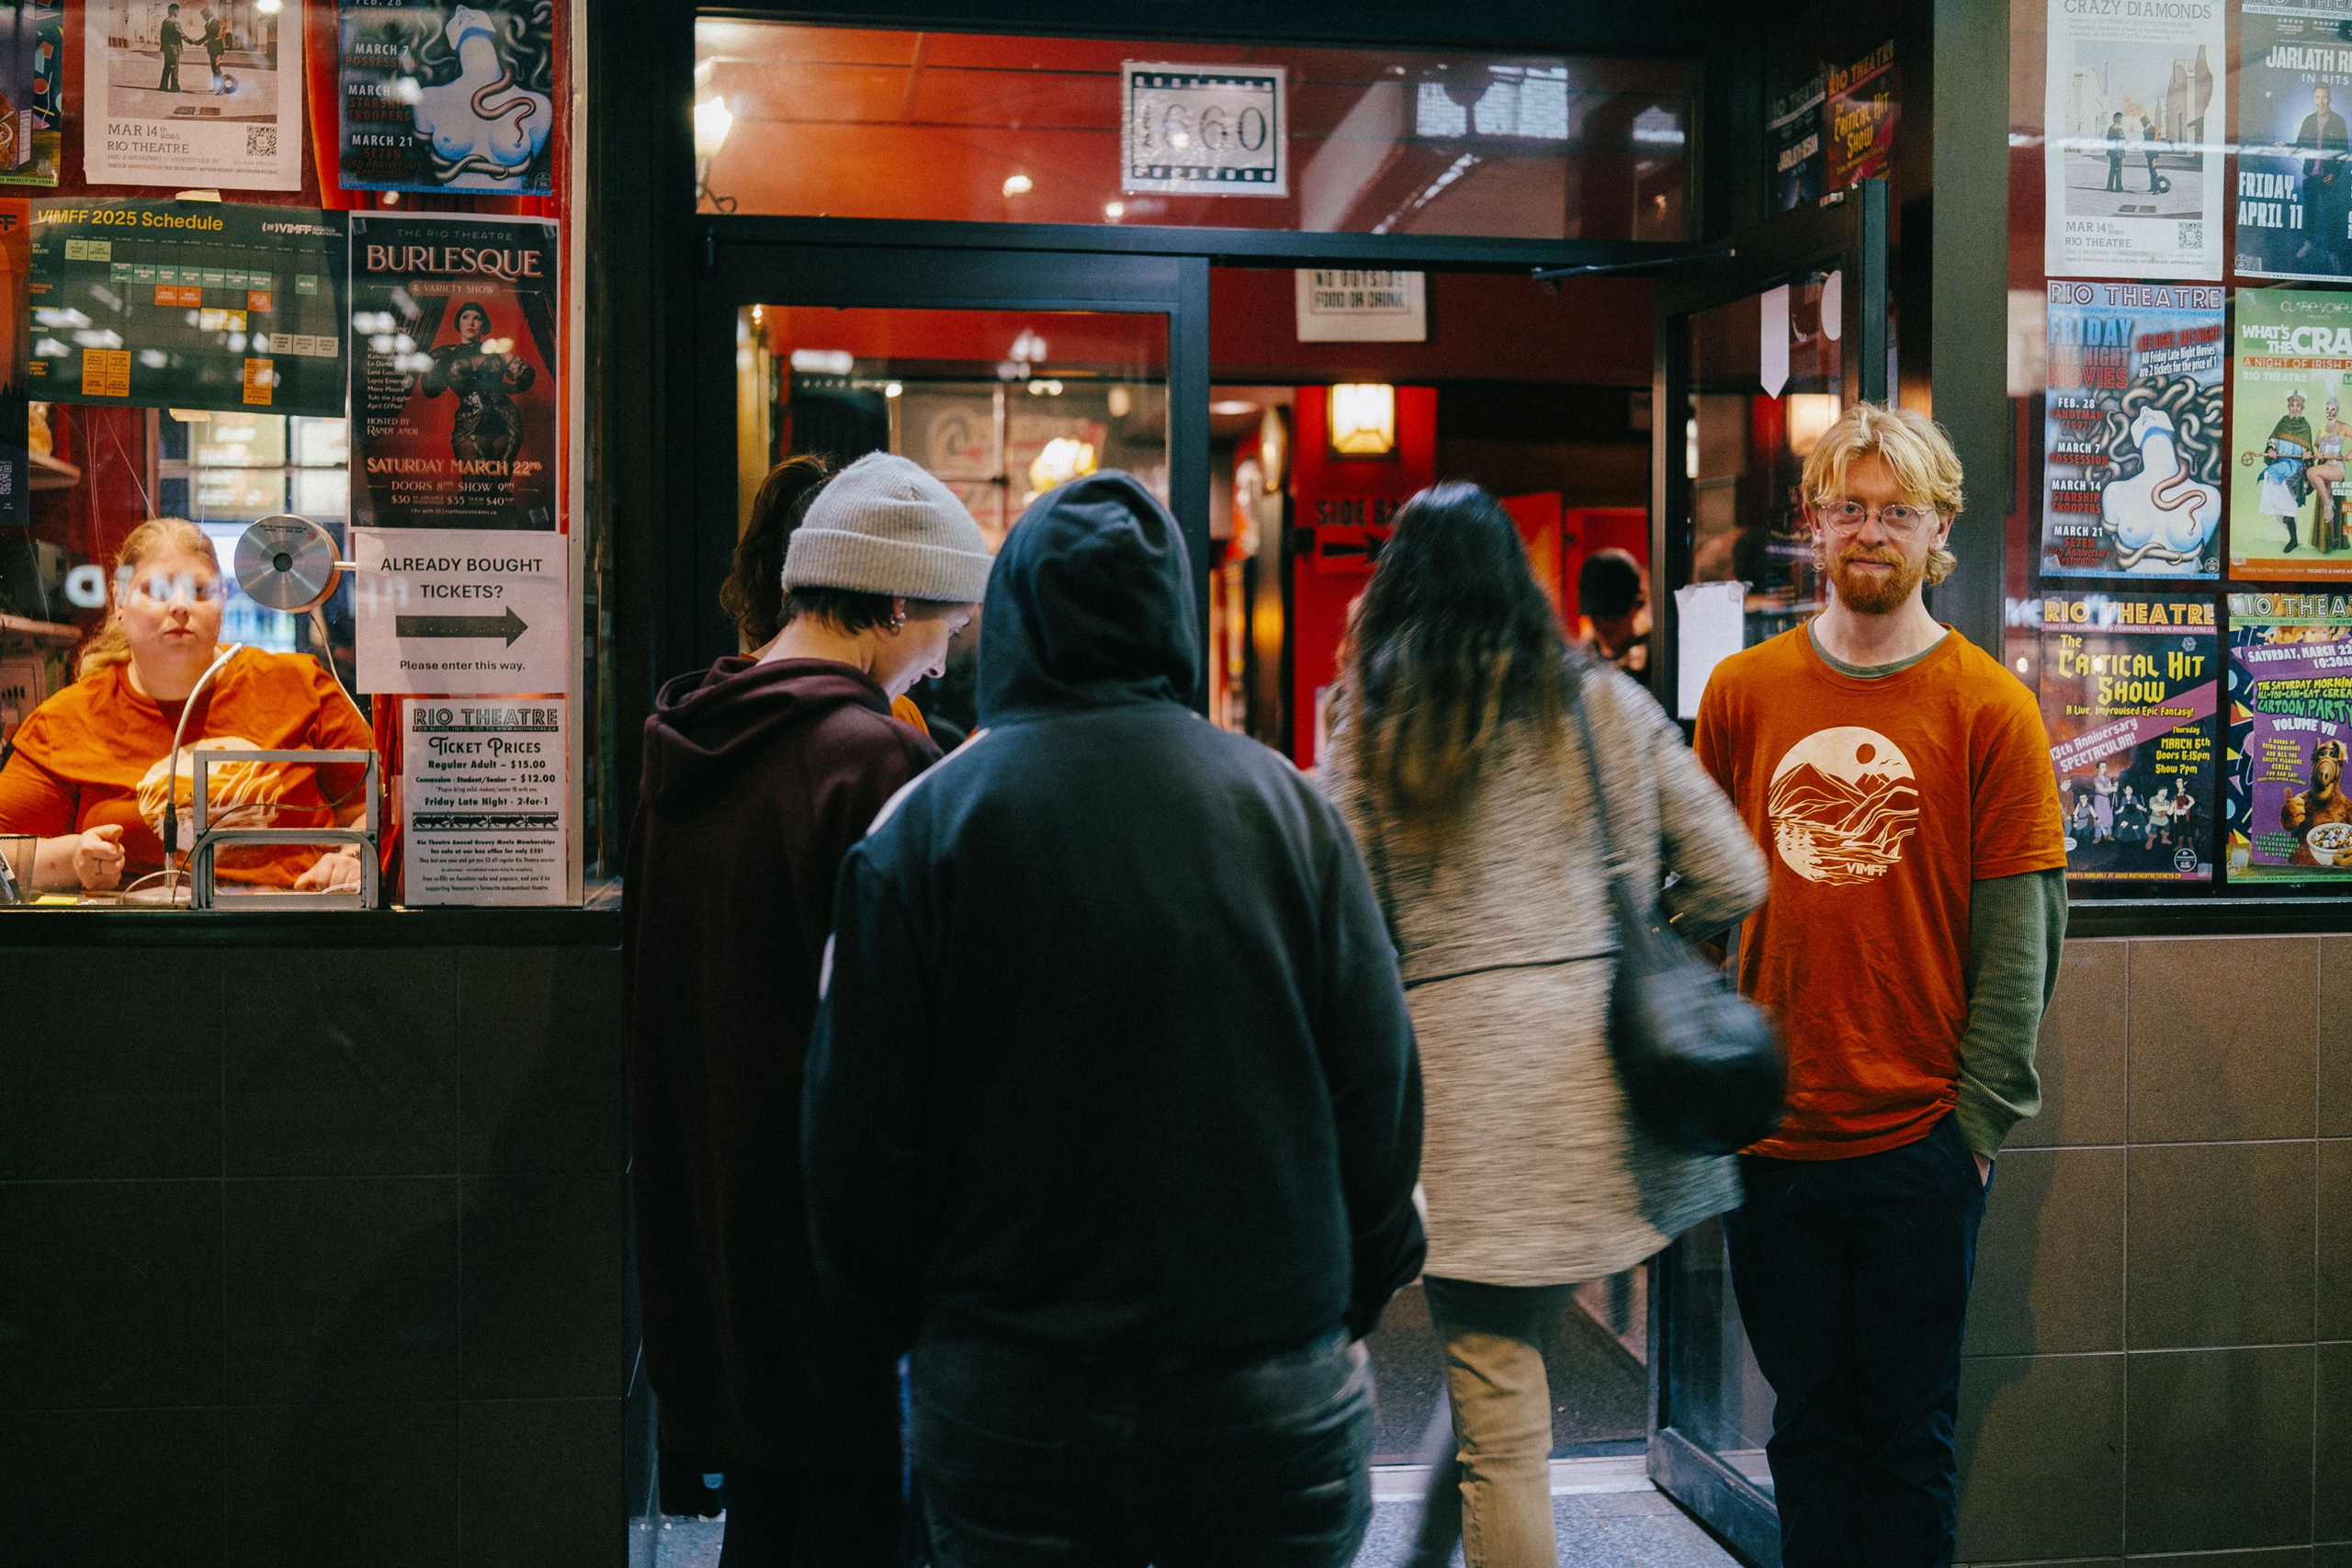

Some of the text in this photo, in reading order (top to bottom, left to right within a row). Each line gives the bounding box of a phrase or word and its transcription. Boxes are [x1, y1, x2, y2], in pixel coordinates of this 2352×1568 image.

[2064, 0, 2211, 19] CRAZY DIAMONDS
[355, 43, 398, 55] MARCH
[2266, 46, 2335, 72] JARLATH
[2301, 73, 2350, 85] IN BITS
[348, 85, 390, 96] MARCH
[348, 109, 411, 121] TROOPERS
[107, 124, 158, 137] MAR 14
[107, 141, 190, 154] RIO THEATRE
[352, 135, 413, 147] MARCH 21
[1847, 125, 1873, 159] SHOW
[2238, 171, 2298, 202] FRIDAY,
[38, 209, 223, 231] VIMFF 2025 Schedule
[2237, 200, 2303, 230] APRIL 11
[2065, 221, 2106, 233] MAR 14
[397, 229, 514, 242] THE RIO THEATRE
[2065, 237, 2132, 248] RIO THEATRE
[367, 244, 543, 282] BURLESQUE
[424, 284, 495, 294] VARIETY SHOW
[2050, 283, 2222, 310] RIO THEATRE
[2049, 317, 2133, 346] FRIDAY
[2136, 324, 2222, 352] LATE DATE NIGHT!
[2242, 324, 2291, 340] WHAT'S
[2267, 340, 2293, 354] THE
[2083, 346, 2131, 367] NIGHT
[2150, 343, 2215, 365] Friday Late Night Movies
[2154, 361, 2173, 376] tickets
[2255, 358, 2342, 369] NIGHT OF IRISH
[2048, 367, 2130, 389] MOVIES
[2242, 370, 2308, 382] RIO THEATRE
[2058, 398, 2096, 409] FEB. 28
[368, 417, 399, 425] HOSTED
[2050, 409, 2104, 421] CANDYMAN
[367, 425, 395, 436] RANDY
[2061, 420, 2092, 432] (1992)
[2057, 442, 2101, 454] MARCH 7
[368, 457, 446, 474] SATURDAY
[450, 458, 508, 476] MARCH
[2049, 454, 2109, 466] POSSESSION
[391, 480, 433, 491] DOORS
[458, 481, 493, 492] SHOW
[2052, 479, 2101, 492] MARCH 14
[391, 494, 505, 506] $30 $40
[2052, 491, 2101, 503] STARSHIP
[1317, 499, 1366, 526] SIDE
[2051, 502, 2102, 514] TROOPERS
[2053, 525, 2103, 537] MARCH 21
[2064, 537, 2095, 548] SE7EN
[2064, 547, 2111, 558] Anniversary
[380, 558, 543, 572] ALREADY BOUGHT
[420, 584, 503, 598] TICKETS?
[2043, 600, 2215, 626] RIO THEATRE
[2154, 626, 2215, 634] WWW.RIOTHEATRE.CA
[2060, 634, 2082, 649] The
[2247, 645, 2336, 662] SATURDAY, MARCH
[400, 660, 526, 672] Please enter this way.
[2058, 649, 2205, 682] CRITICAL HIT
[2098, 676, 2165, 706] SHOW
[2256, 679, 2312, 691] THE SATURDAY
[2256, 689, 2321, 699] ALL-YOU-CAN-EAT
[2074, 705, 2194, 718] Live, Improvised Epic Fantasy!
[2256, 699, 2306, 717] CARTOON
[413, 708, 558, 726] RIO THEATRE
[2074, 717, 2139, 750] Anniversary
[2172, 726, 2200, 735] Thursday
[2272, 717, 2338, 737] VOLUME VII
[2161, 737, 2211, 750] MARCH 6th
[2059, 731, 2136, 773] SPECTACULAR!
[2156, 750, 2211, 761] Doors 6:15pm
[428, 761, 468, 771] Regular
[470, 760, 497, 769] Adult
[2155, 763, 2198, 776] Show 7pm
[457, 775, 507, 784] Student/Senior
[424, 796, 548, 807] Friday Late Night 2-for-1
[1846, 862, 1888, 877] VIMFF
